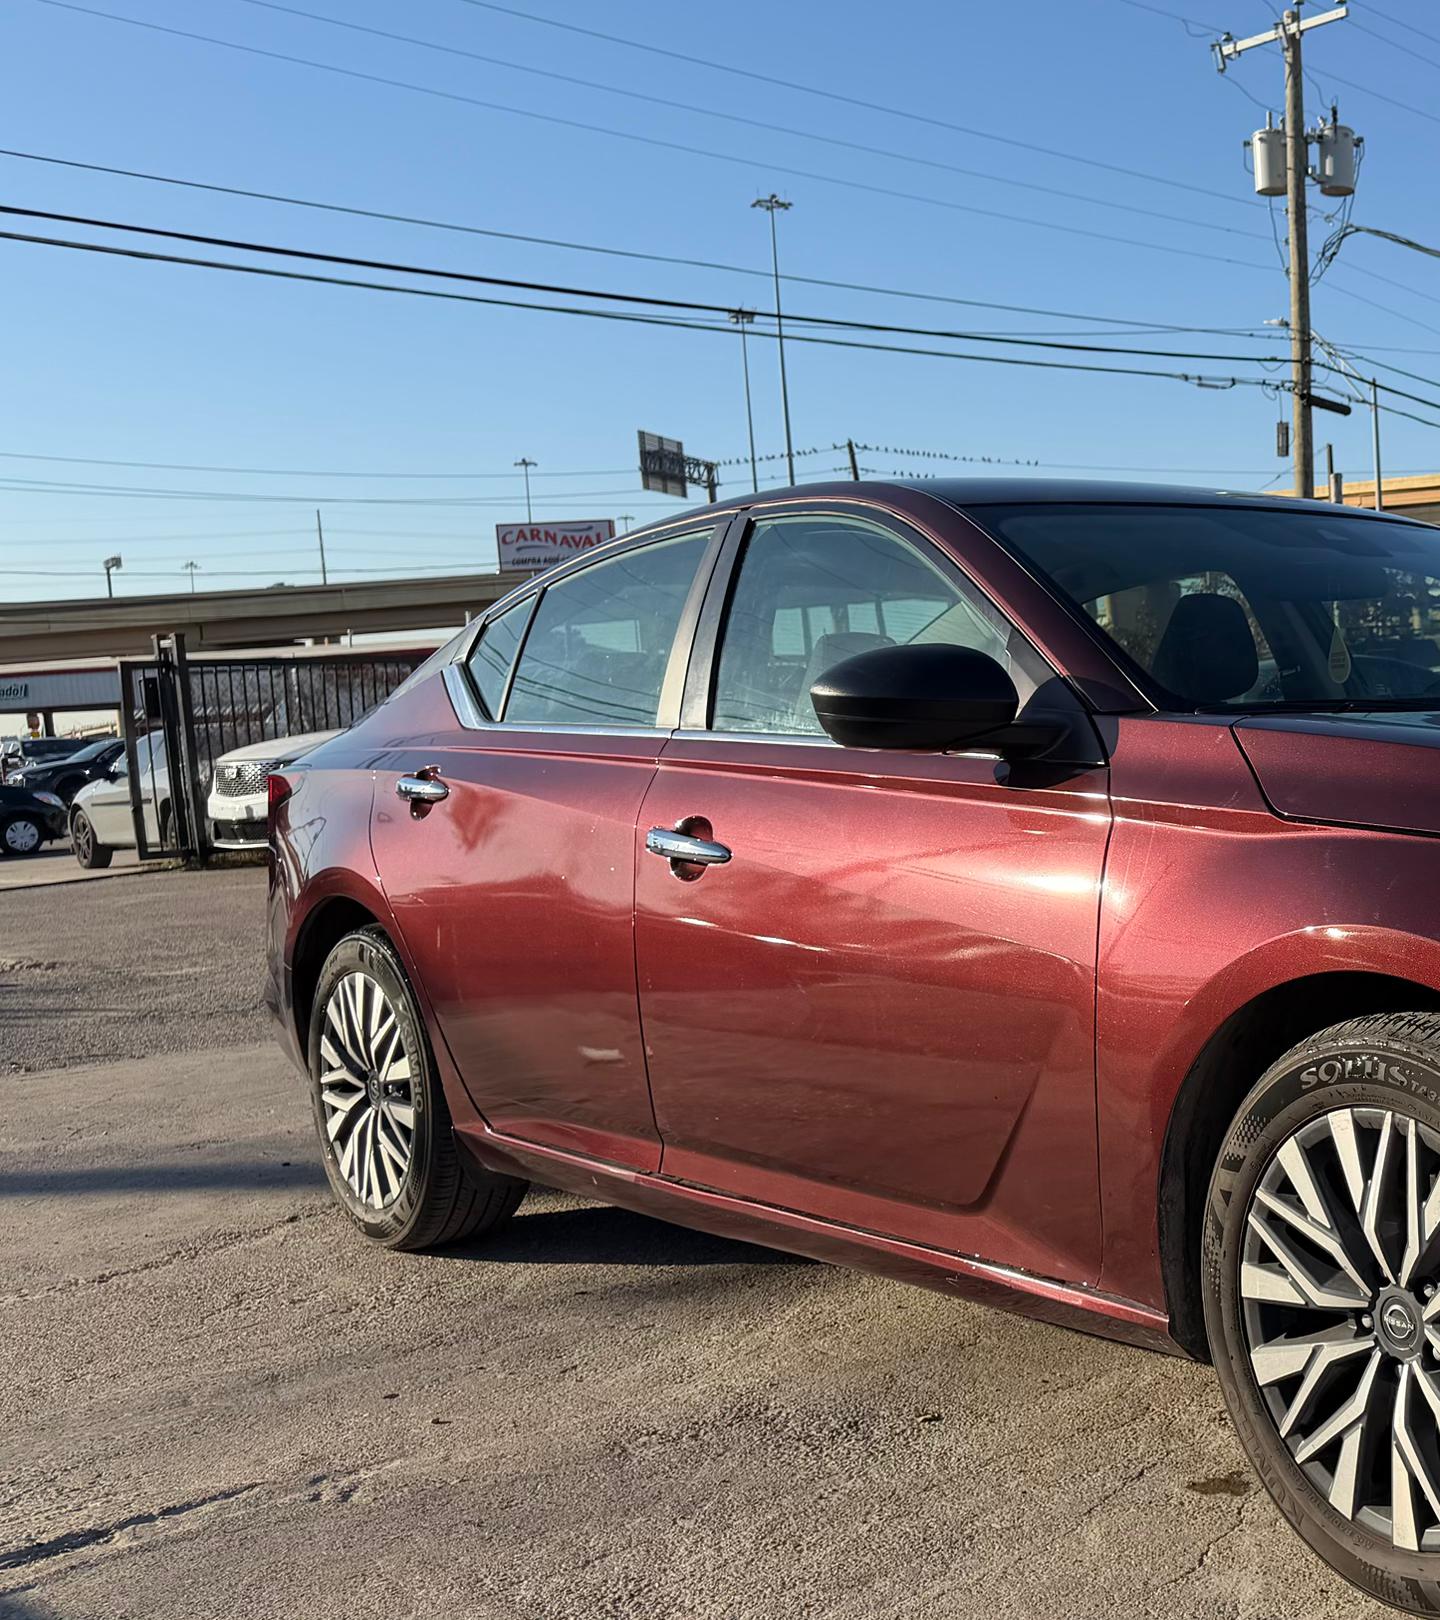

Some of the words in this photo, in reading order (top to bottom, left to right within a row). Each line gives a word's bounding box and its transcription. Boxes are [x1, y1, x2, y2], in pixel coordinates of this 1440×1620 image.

[401, 1021, 424, 1113] KUMHO
[1300, 1060, 1408, 1090] SOLUS
[1384, 1314, 1414, 1331] NISSAN
